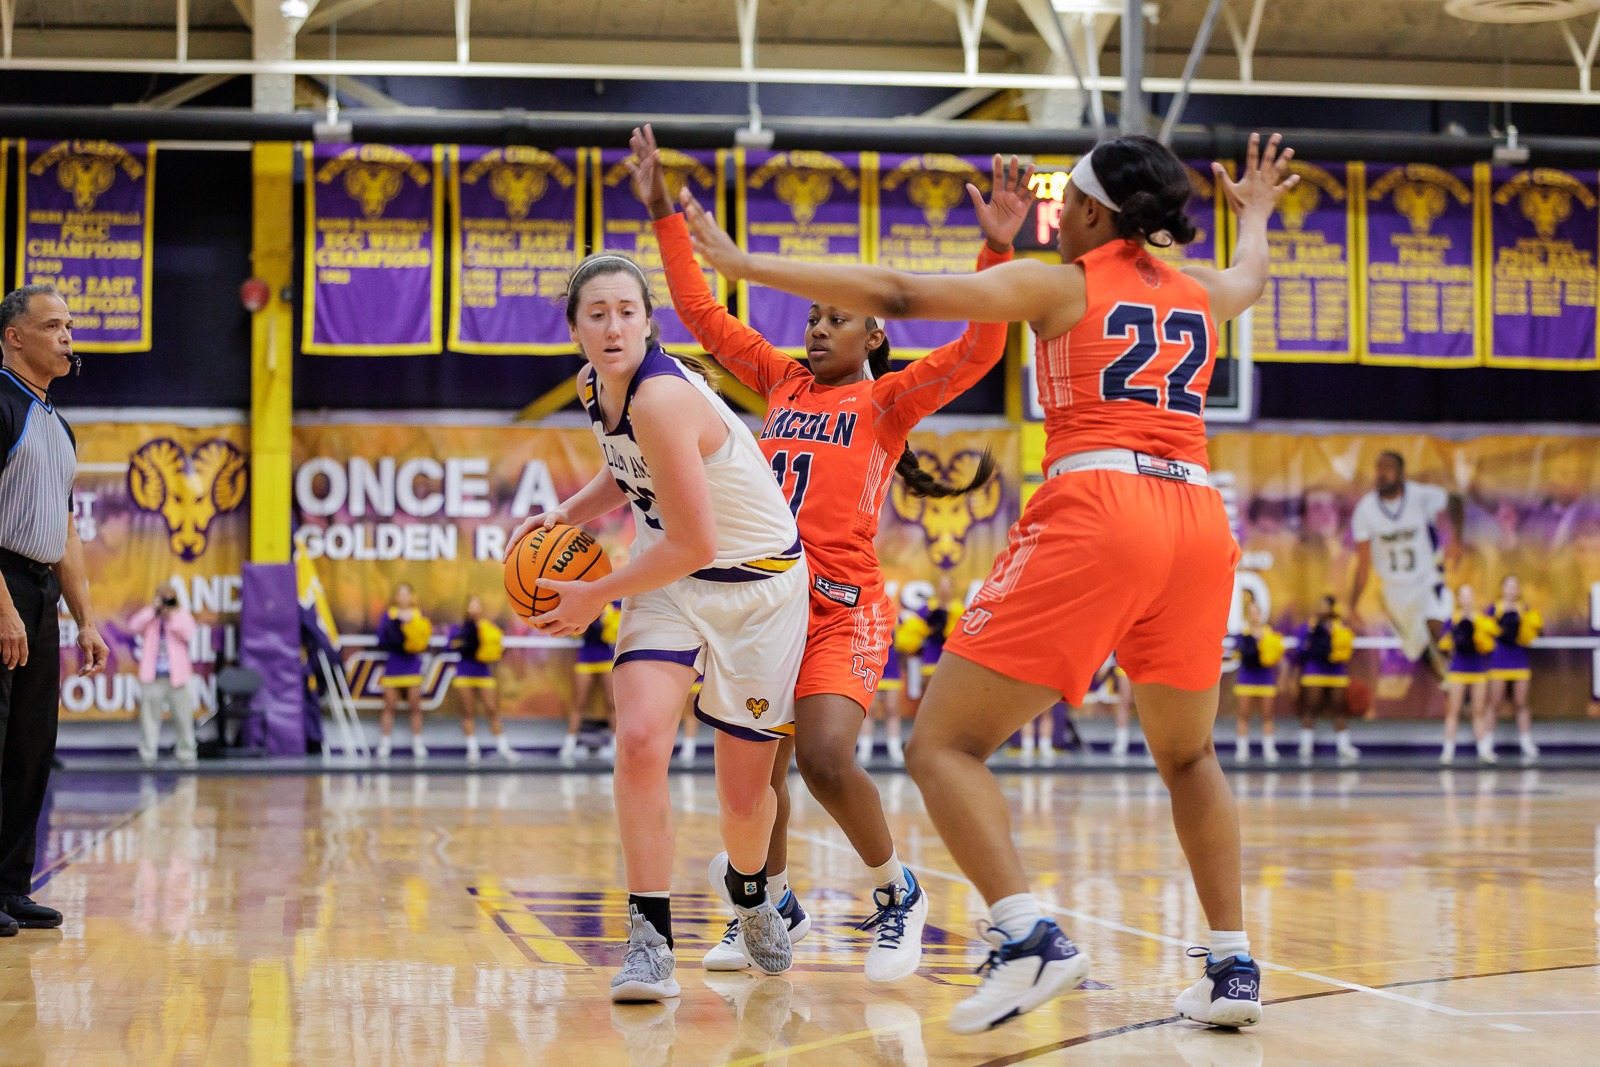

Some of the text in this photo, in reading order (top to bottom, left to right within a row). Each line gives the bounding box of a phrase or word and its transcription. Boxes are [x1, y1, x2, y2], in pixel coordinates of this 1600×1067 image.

[27, 240, 142, 259] CHAMPIONS
[85, 277, 136, 296] EAST
[1099, 300, 1210, 419] 22
[760, 407, 858, 449] LINCOLN
[295, 456, 562, 519] ONCE A
[770, 449, 814, 521] 11
[298, 523, 458, 562] GOLDEN
